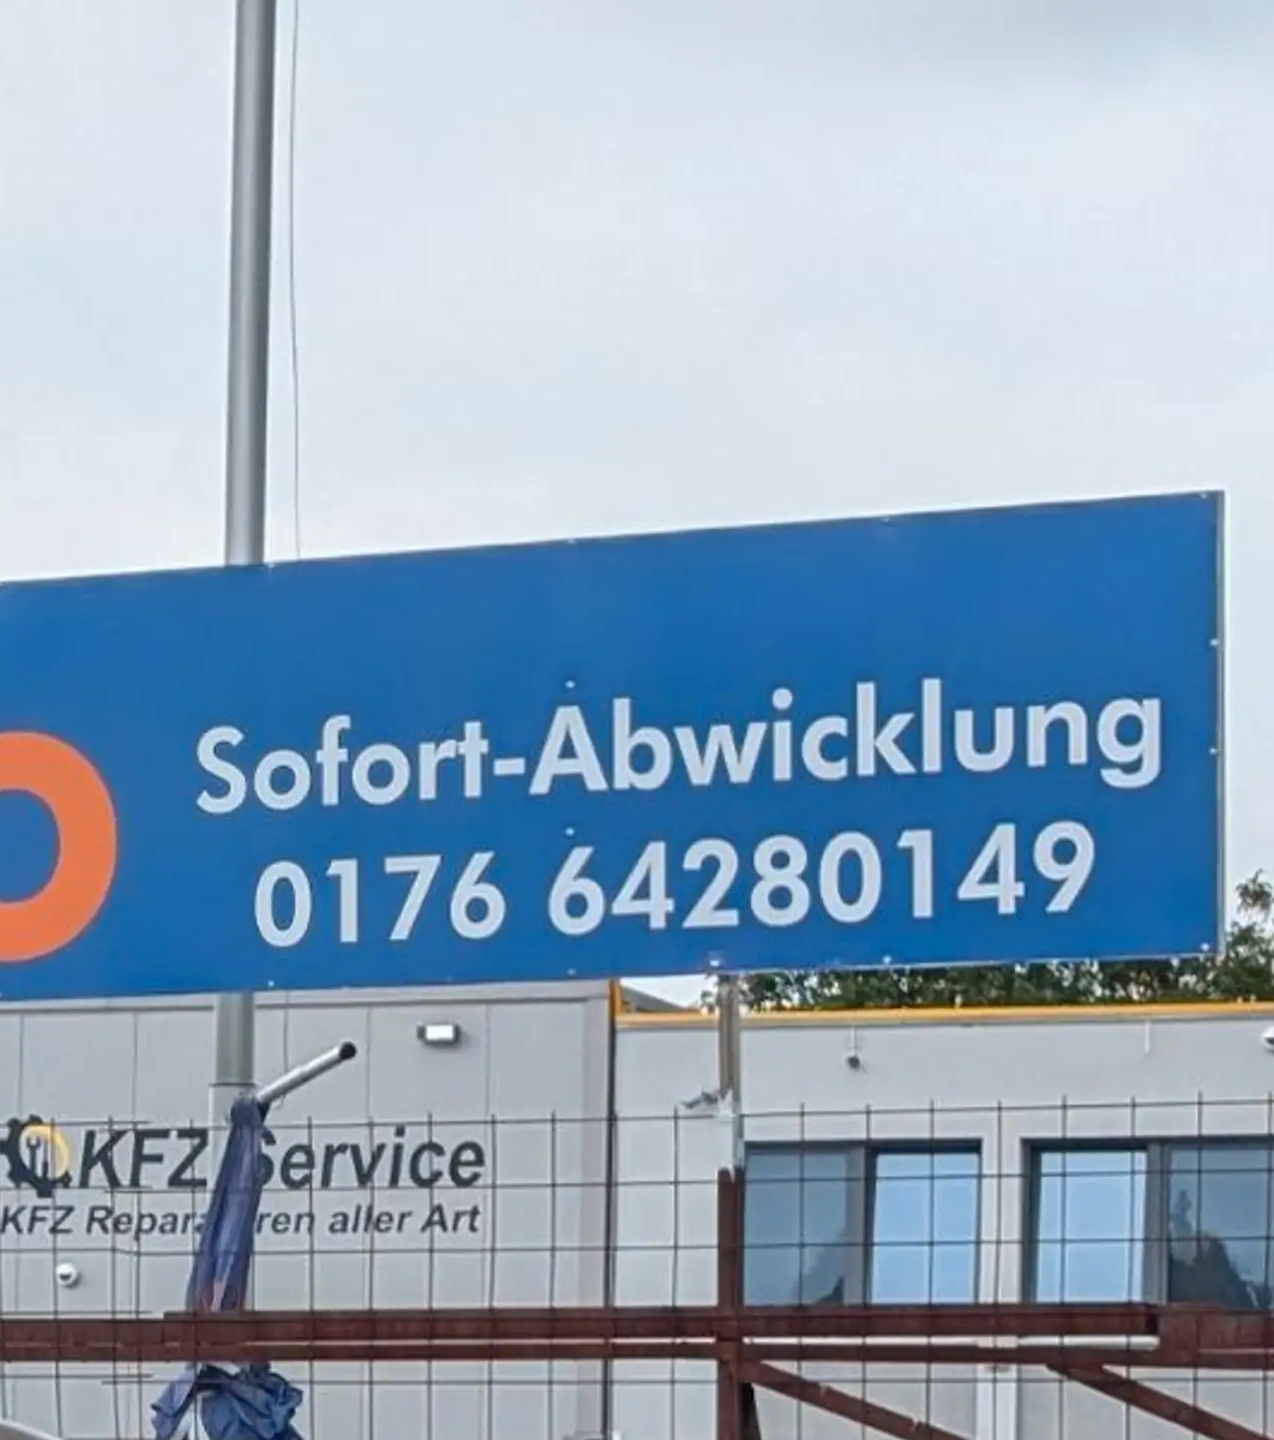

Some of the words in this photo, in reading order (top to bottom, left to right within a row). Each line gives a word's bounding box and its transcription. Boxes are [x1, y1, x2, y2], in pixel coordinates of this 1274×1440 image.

[196, 678, 1162, 814] Sofort-Abwicklung
[254, 851, 506, 948] 0176
[548, 820, 1096, 937] 64280149
[79, 1129, 210, 1189] KFZ
[0, 1205, 75, 1235] KFZ
[86, 1205, 315, 1242] Reparren
[328, 1203, 413, 1234] aller
[420, 1203, 481, 1233] Art
